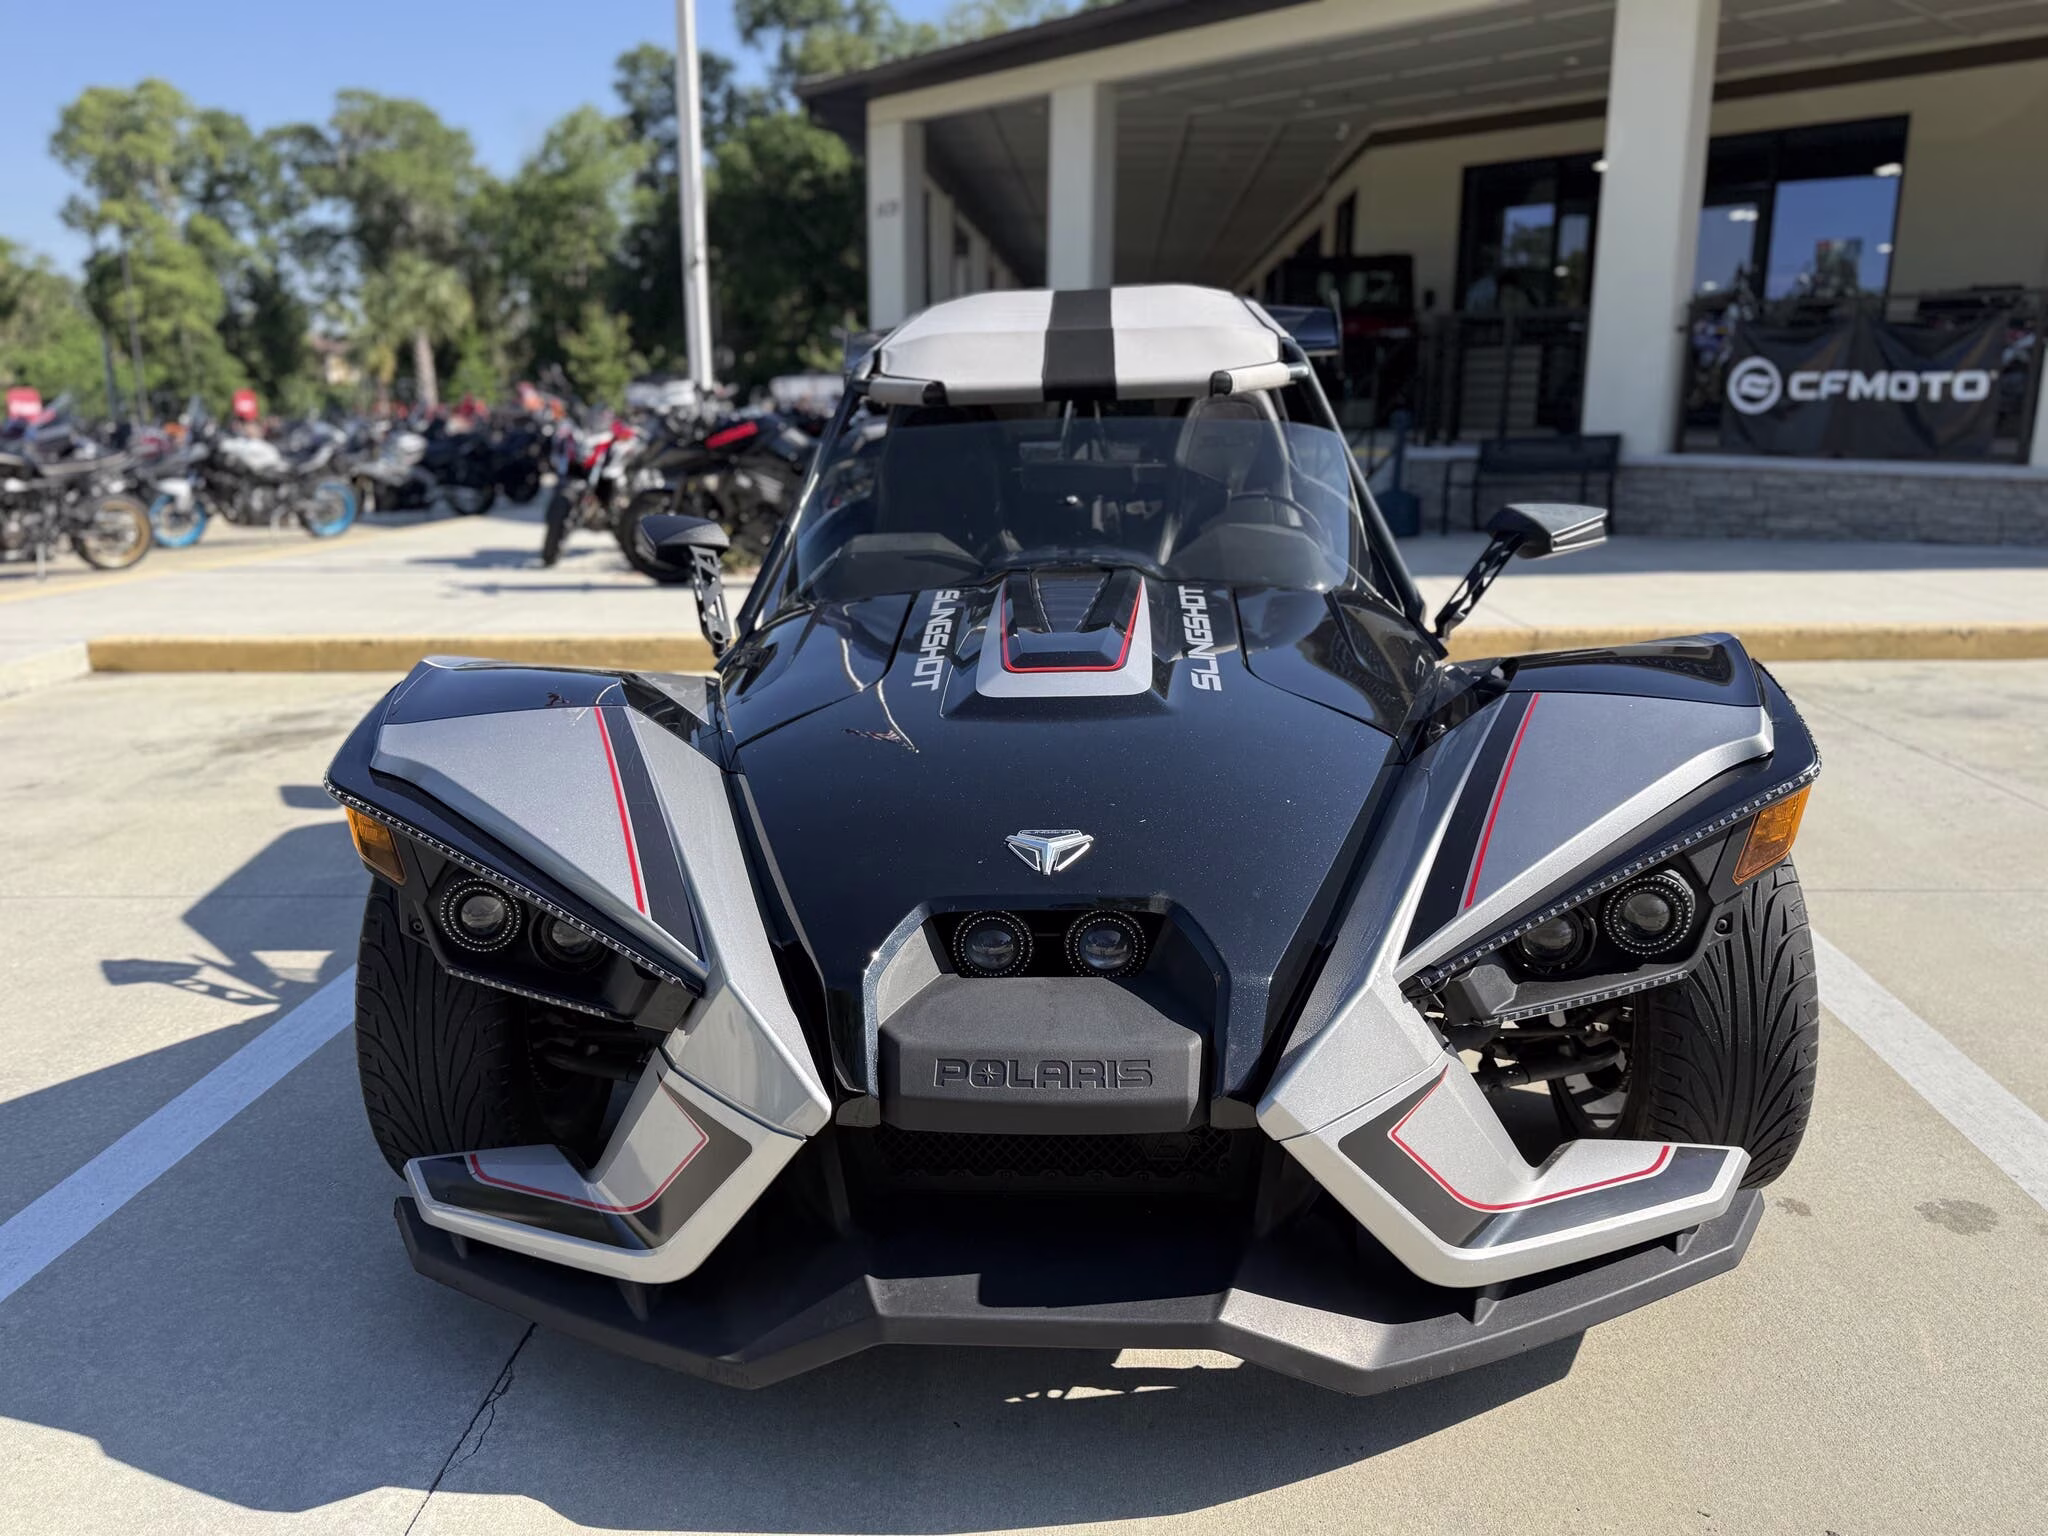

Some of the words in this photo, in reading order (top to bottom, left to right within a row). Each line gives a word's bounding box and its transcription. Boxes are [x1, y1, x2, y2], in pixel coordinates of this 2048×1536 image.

[1787, 369, 1991, 401] CFMOTO
[911, 589, 960, 691] SLINGSHOT
[1178, 585, 1223, 691] SLINGSHOT
[934, 1058, 1153, 1089] POLARIS
